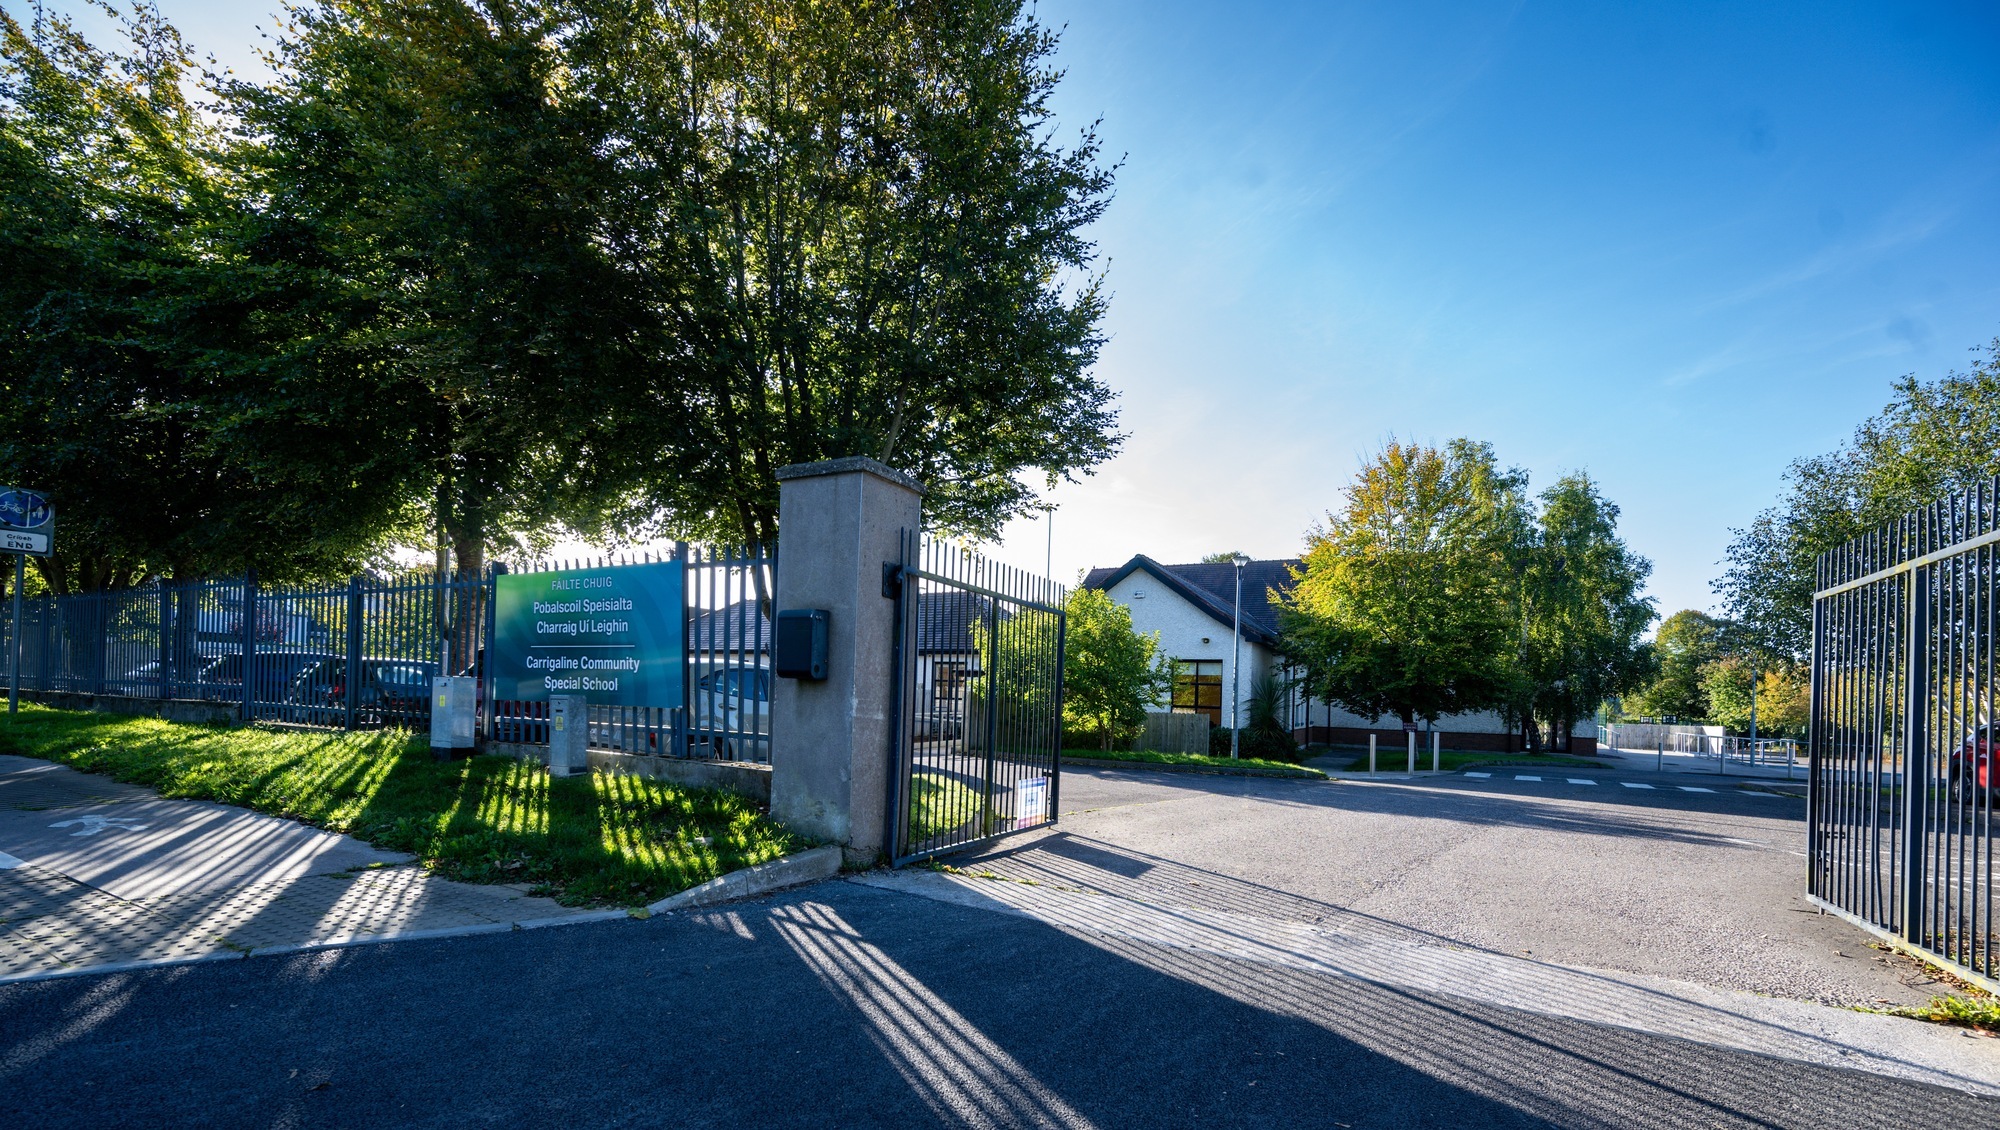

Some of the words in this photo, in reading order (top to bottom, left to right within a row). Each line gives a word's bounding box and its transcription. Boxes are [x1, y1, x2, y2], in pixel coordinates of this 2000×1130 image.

[7, 541, 33, 549] END
[551, 577, 581, 591] FÁILTE
[583, 576, 612, 589] CHUIG
[533, 599, 581, 614] Pobalscoil
[583, 597, 633, 615] Speisialta
[536, 620, 577, 636] Charraig
[579, 619, 590, 633] Uí
[591, 619, 629, 636] Leighin
[526, 656, 579, 672] Carrigaline
[580, 656, 640, 673] Community
[544, 675, 581, 692] Special
[582, 676, 618, 691] School
